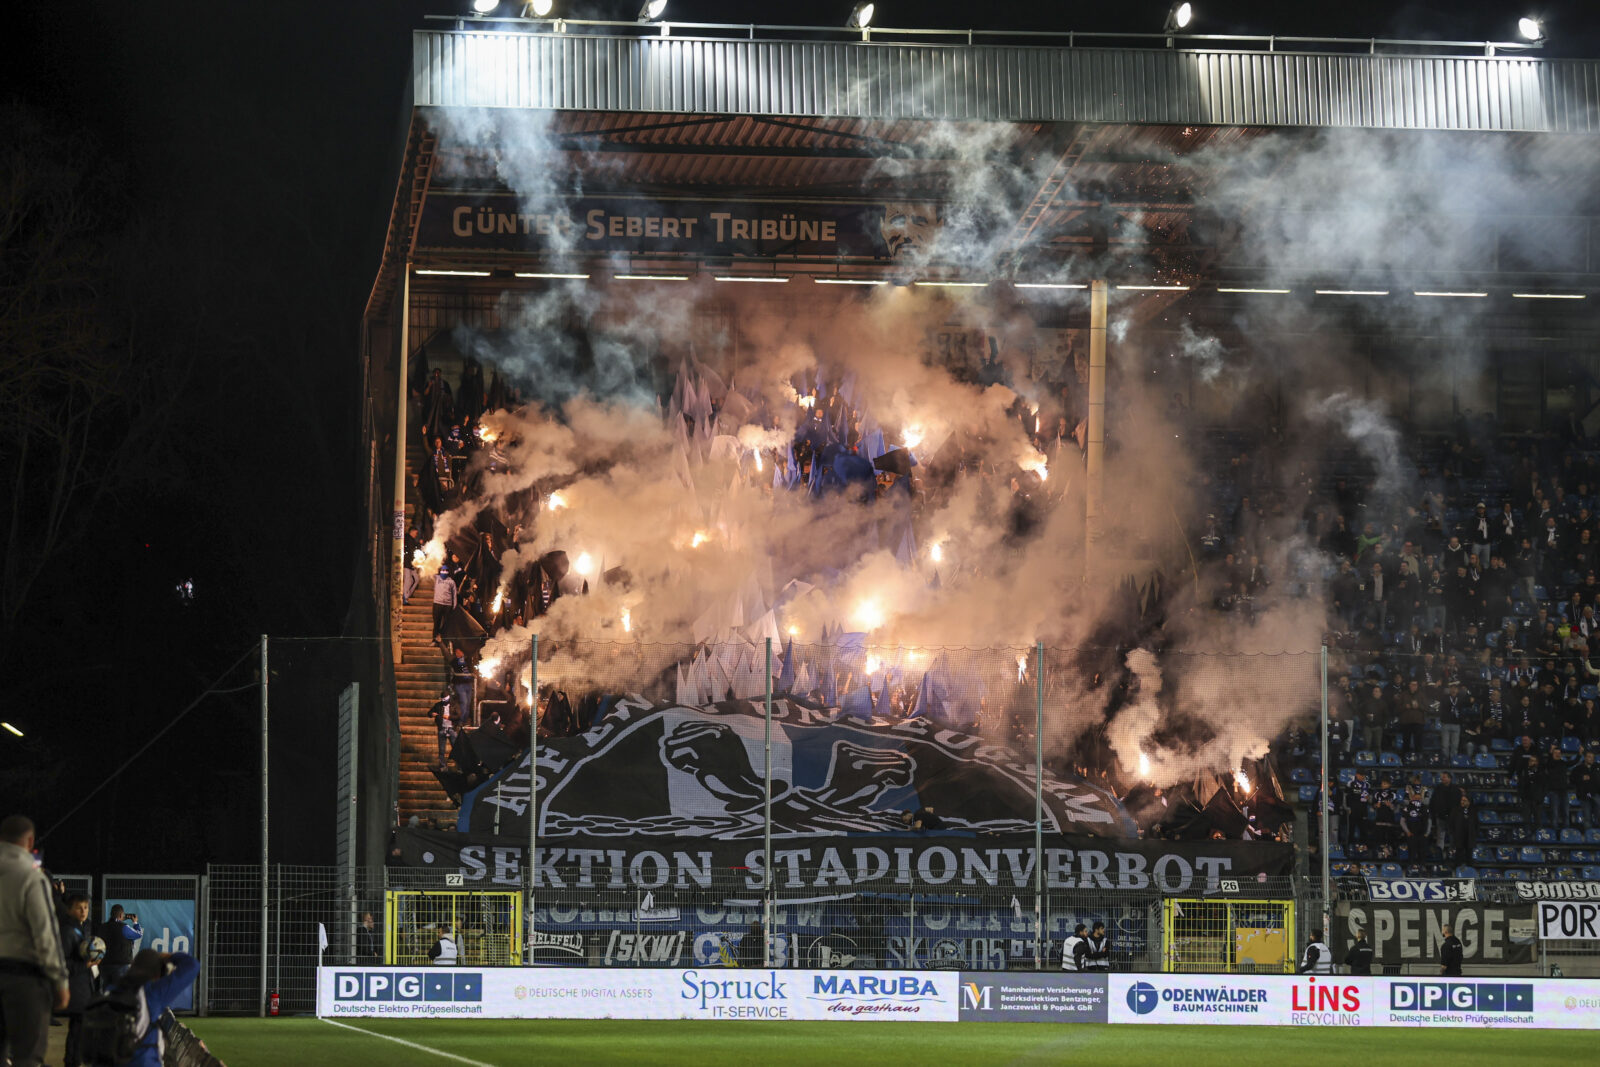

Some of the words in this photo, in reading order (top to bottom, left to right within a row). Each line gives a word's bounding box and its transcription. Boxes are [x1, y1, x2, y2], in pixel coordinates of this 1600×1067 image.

[586, 209, 698, 240] SEBERT
[711, 212, 836, 243] TRIBÜNE
[483, 744, 569, 817] AUF
[458, 845, 713, 890] SEKTION
[744, 846, 1233, 896] STADIONVERBOT
[447, 875, 462, 885] 27
[1223, 881, 1237, 891] 26
[1369, 881, 1446, 901] BOYS
[1541, 904, 1600, 937] POR
[1346, 906, 1505, 959] SPENGE
[528, 931, 583, 950] IELEFELD
[338, 975, 420, 998] DPG
[529, 988, 578, 998] DEUTSCHE
[581, 988, 617, 998] DIGITAL
[619, 988, 654, 998] ASSETS
[681, 970, 788, 1010] Spruck
[1000, 986, 1045, 994] Mannheimer
[1046, 986, 1092, 995] Versicherung
[1000, 994, 1059, 1002] Bezirksdirektion
[1061, 995, 1101, 1004] Bentzinger,
[1162, 985, 1268, 1003] ODENWÄLDER
[1394, 985, 1473, 1008] DPG
[333, 1004, 376, 1013] Deutsche
[378, 1004, 410, 1013] Elektro
[412, 1004, 482, 1015] Prüfgesellschaft
[713, 1006, 788, 1018] IT-SERVICE
[827, 1001, 855, 1013] das
[851, 1001, 920, 1015] gasthaus
[1000, 1003, 1041, 1011] Janczewski
[1172, 1003, 1259, 1013] BAUMASCHINEN
[1291, 1012, 1360, 1025] RECYCLING
[1390, 1013, 1431, 1023] Deutsche
[1433, 1013, 1463, 1023] Elektro
[1464, 1014, 1534, 1025] Prüfgesellschaft
